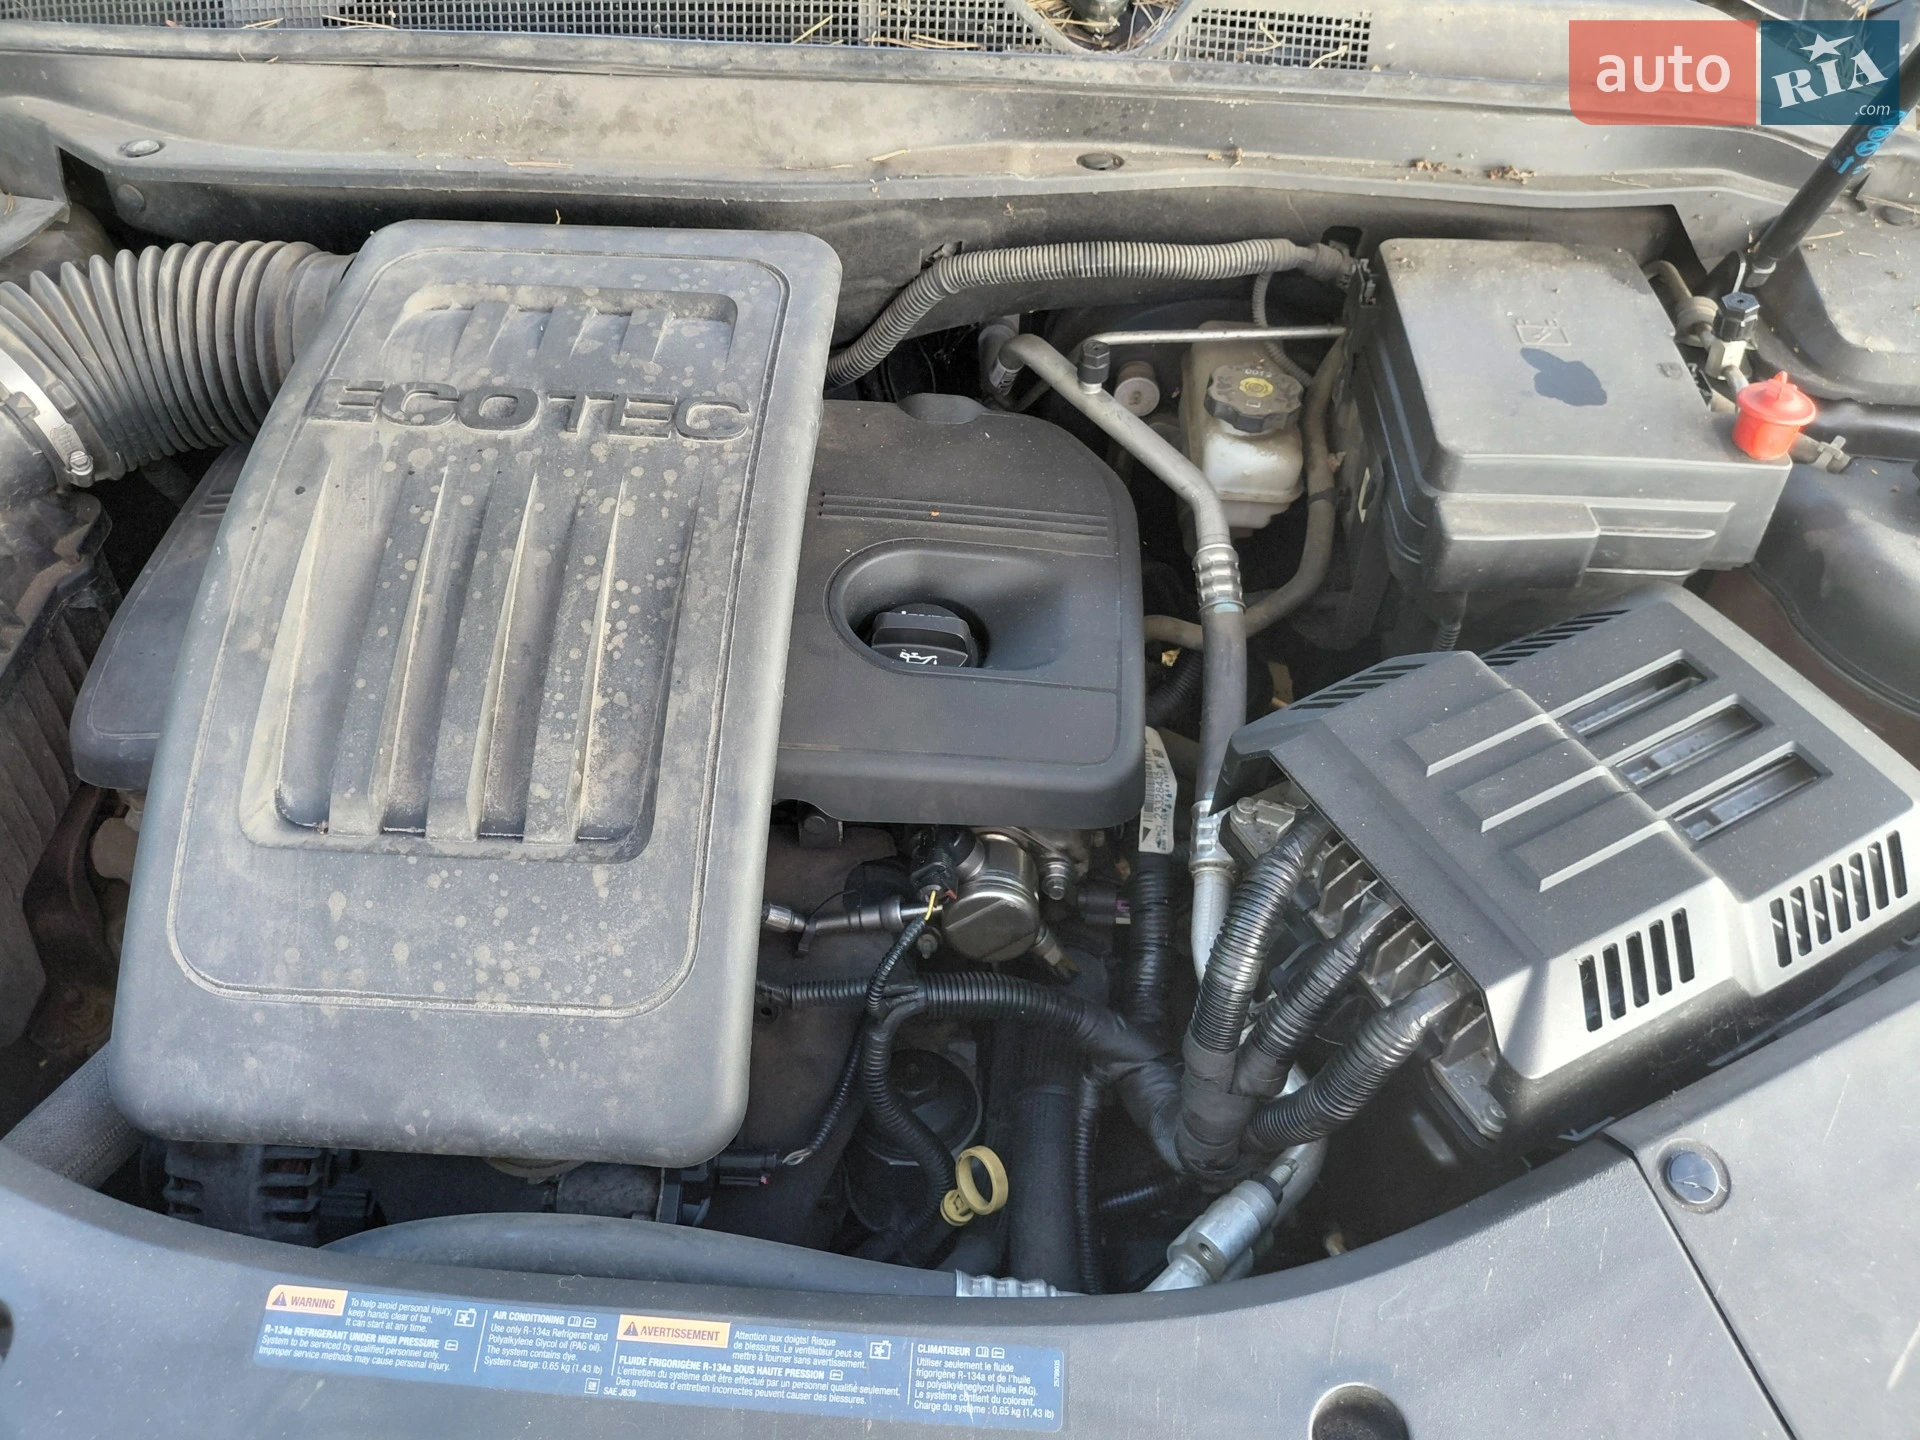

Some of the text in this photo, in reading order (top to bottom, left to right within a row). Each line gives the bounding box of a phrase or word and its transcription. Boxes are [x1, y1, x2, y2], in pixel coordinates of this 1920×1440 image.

[309, 378, 751, 442] ECOTEC
[291, 1296, 335, 1309] WARNING
[360, 1299, 376, 1310] help
[377, 1302, 397, 1310] avoid
[398, 1304, 430, 1313] personal
[431, 1305, 452, 1316] injury,
[347, 1308, 366, 1318] keep
[367, 1309, 389, 1319] hands
[390, 1312, 408, 1321] clear
[419, 1314, 432, 1323] fan.
[493, 1311, 564, 1324] AIR CONDITIONING
[366, 1320, 384, 1328] start
[394, 1324, 408, 1332] any
[409, 1324, 427, 1332] time.
[490, 1323, 608, 1341] Use only R-134a Refrigerant and
[641, 1326, 719, 1340] AVERTISSEMENT
[264, 1324, 439, 1348] R-134a REFRIGERANT UNDER HIGH PRESSURE
[488, 1334, 601, 1353] Polyalkylene Glycol oil (PAG oil).
[734, 1331, 767, 1341] Attention
[784, 1335, 809, 1345] doigts!
[811, 1337, 836, 1347] Risque
[261, 1335, 289, 1346] System
[310, 1341, 341, 1350] serviced
[353, 1344, 384, 1354] qualified
[385, 1348, 422, 1357] personnel
[422, 1350, 439, 1360] only.
[487, 1344, 577, 1362] The system contains dye.
[744, 1342, 781, 1352] blessures.
[794, 1346, 833, 1356] ventilateur
[835, 1349, 852, 1358] peut
[918, 1344, 970, 1356] CLIMATISEUR
[258, 1345, 449, 1372] Improper service methods may cause personal injury.
[484, 1356, 511, 1366] System
[512, 1359, 540, 1370] charge:
[542, 1361, 559, 1370] 0.65
[572, 1364, 591, 1373] (1.43
[593, 1365, 602, 1375] lb)
[732, 1352, 756, 1360] mettre
[765, 1353, 792, 1363] tourner
[812, 1358, 866, 1368] avertissement.
[916, 1357, 942, 1367] Utiliser
[944, 1360, 982, 1370] seulement
[993, 1363, 1014, 1372] fluide
[619, 1355, 824, 1379] FLUIDE FRIGORIGÈNE R-134a SOUS HAUTE PRESSION
[669, 1371, 700, 1381] système
[701, 1373, 716, 1382] doit
[717, 1374, 732, 1383] être
[734, 1375, 764, 1386] effectué
[766, 1379, 778, 1388] par
[792, 1381, 828, 1390] personnel
[830, 1383, 858, 1393] qualifié
[916, 1368, 955, 1379] frigorigène
[957, 1370, 985, 1381] R-134a
[1008, 1374, 1030, 1384] l'huile
[603, 1387, 636, 1397] SAE J639
[615, 1377, 866, 1404] Des méthodes d'entretien incorrectes peuvent causer des blessures.
[995, 1384, 1016, 1394] (huile
[1018, 1385, 1038, 1396] PAG).
[926, 1391, 957, 1400] système
[959, 1392, 989, 1403] contient
[1002, 1396, 1034, 1406] colorant.
[914, 1400, 940, 1412] Charge
[954, 1403, 985, 1414] système
[992, 1405, 1009, 1415] 0,65
[1022, 1408, 1042, 1418] (1,43
[1044, 1409, 1054, 1420] lb)
